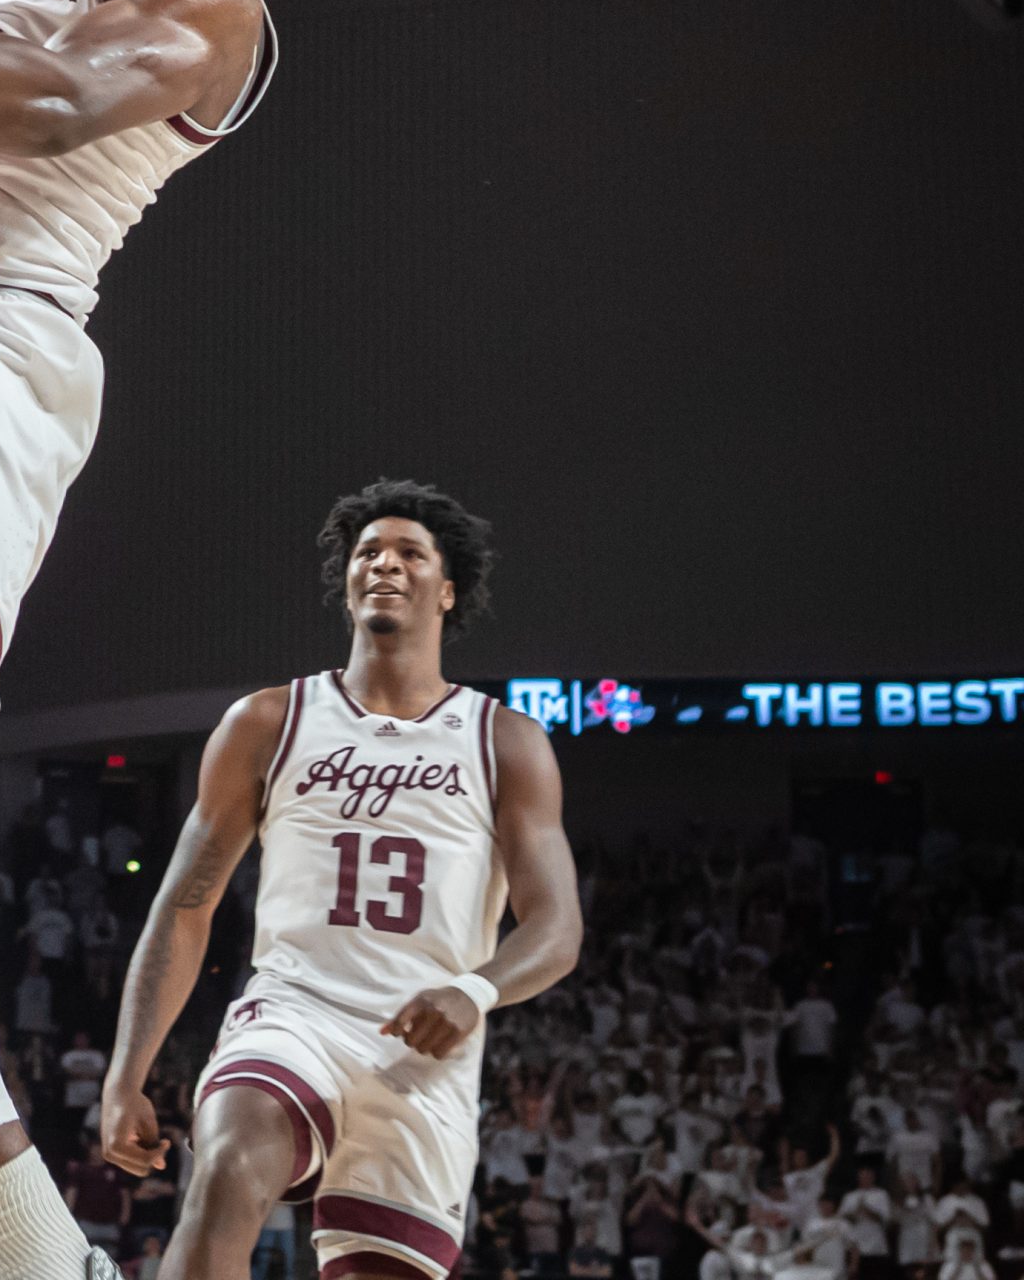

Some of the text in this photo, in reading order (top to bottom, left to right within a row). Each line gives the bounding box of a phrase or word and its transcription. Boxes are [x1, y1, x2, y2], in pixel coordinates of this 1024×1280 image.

[742, 682, 862, 727] THE
[876, 678, 1024, 727] BEST
[295, 745, 468, 820] Aggies
[328, 832, 427, 936] 13
